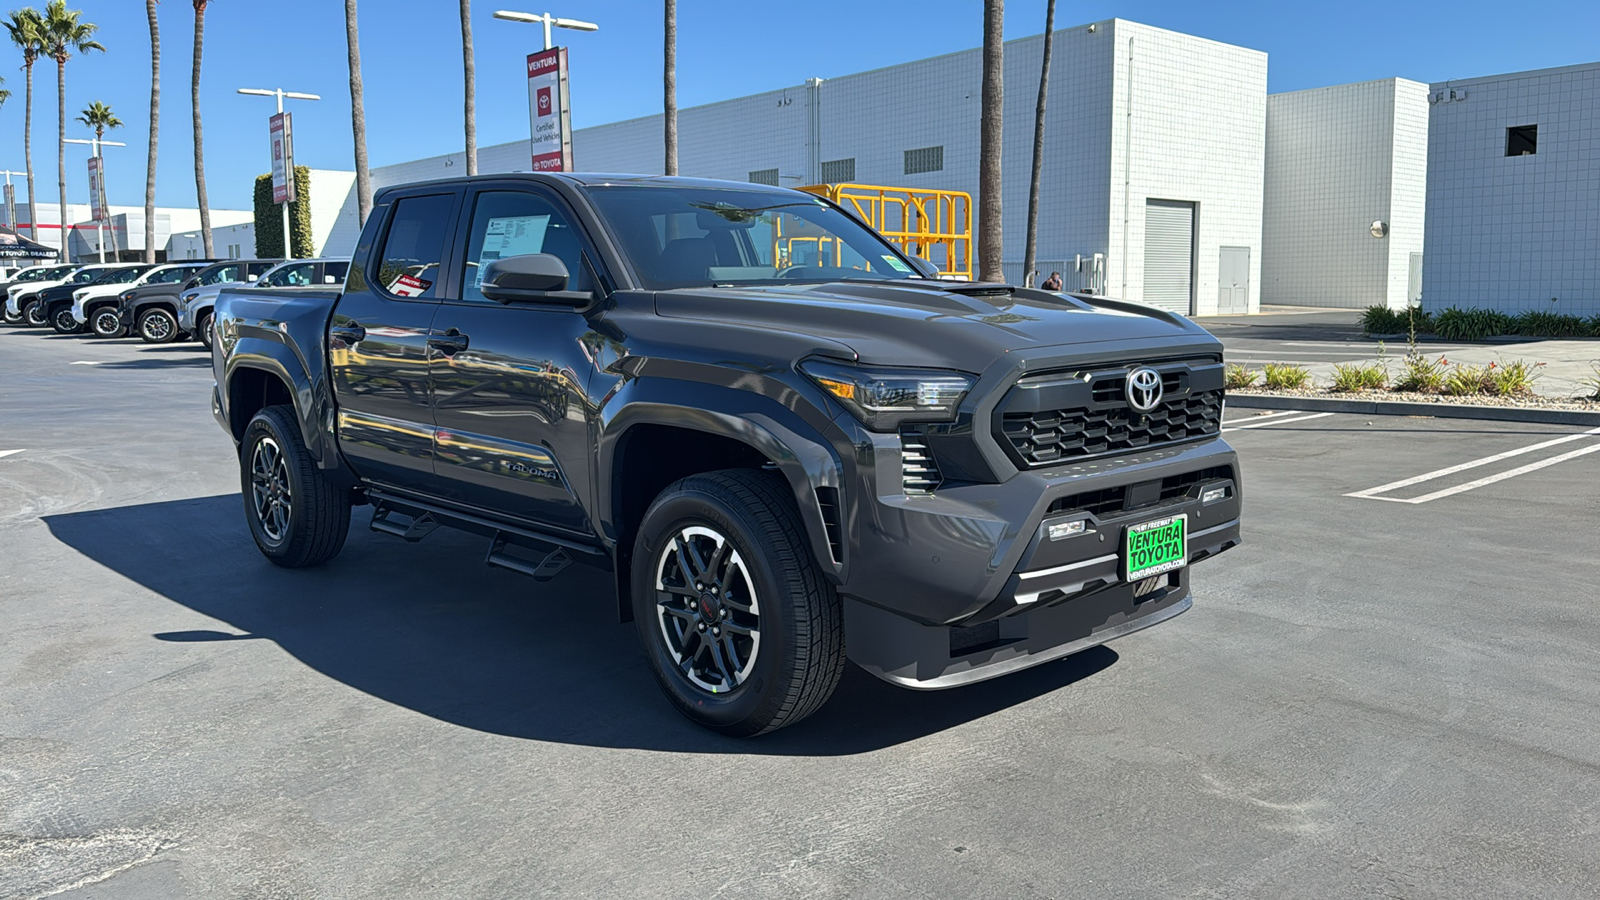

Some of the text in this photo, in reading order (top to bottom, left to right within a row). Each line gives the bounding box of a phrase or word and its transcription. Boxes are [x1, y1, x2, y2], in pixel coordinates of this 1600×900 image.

[528, 55, 557, 72] VENTURA
[536, 121, 555, 133] Certified
[532, 131, 560, 144] Used Vehicles
[540, 157, 562, 169] TOYOTA
[506, 463, 557, 480] TACOMA
[1147, 518, 1171, 530] FREEWAY
[1129, 524, 1180, 552] VENTURA
[1130, 541, 1180, 568] TOYOTA
[1129, 558, 1185, 580] VENTURATOYOTA.COM
